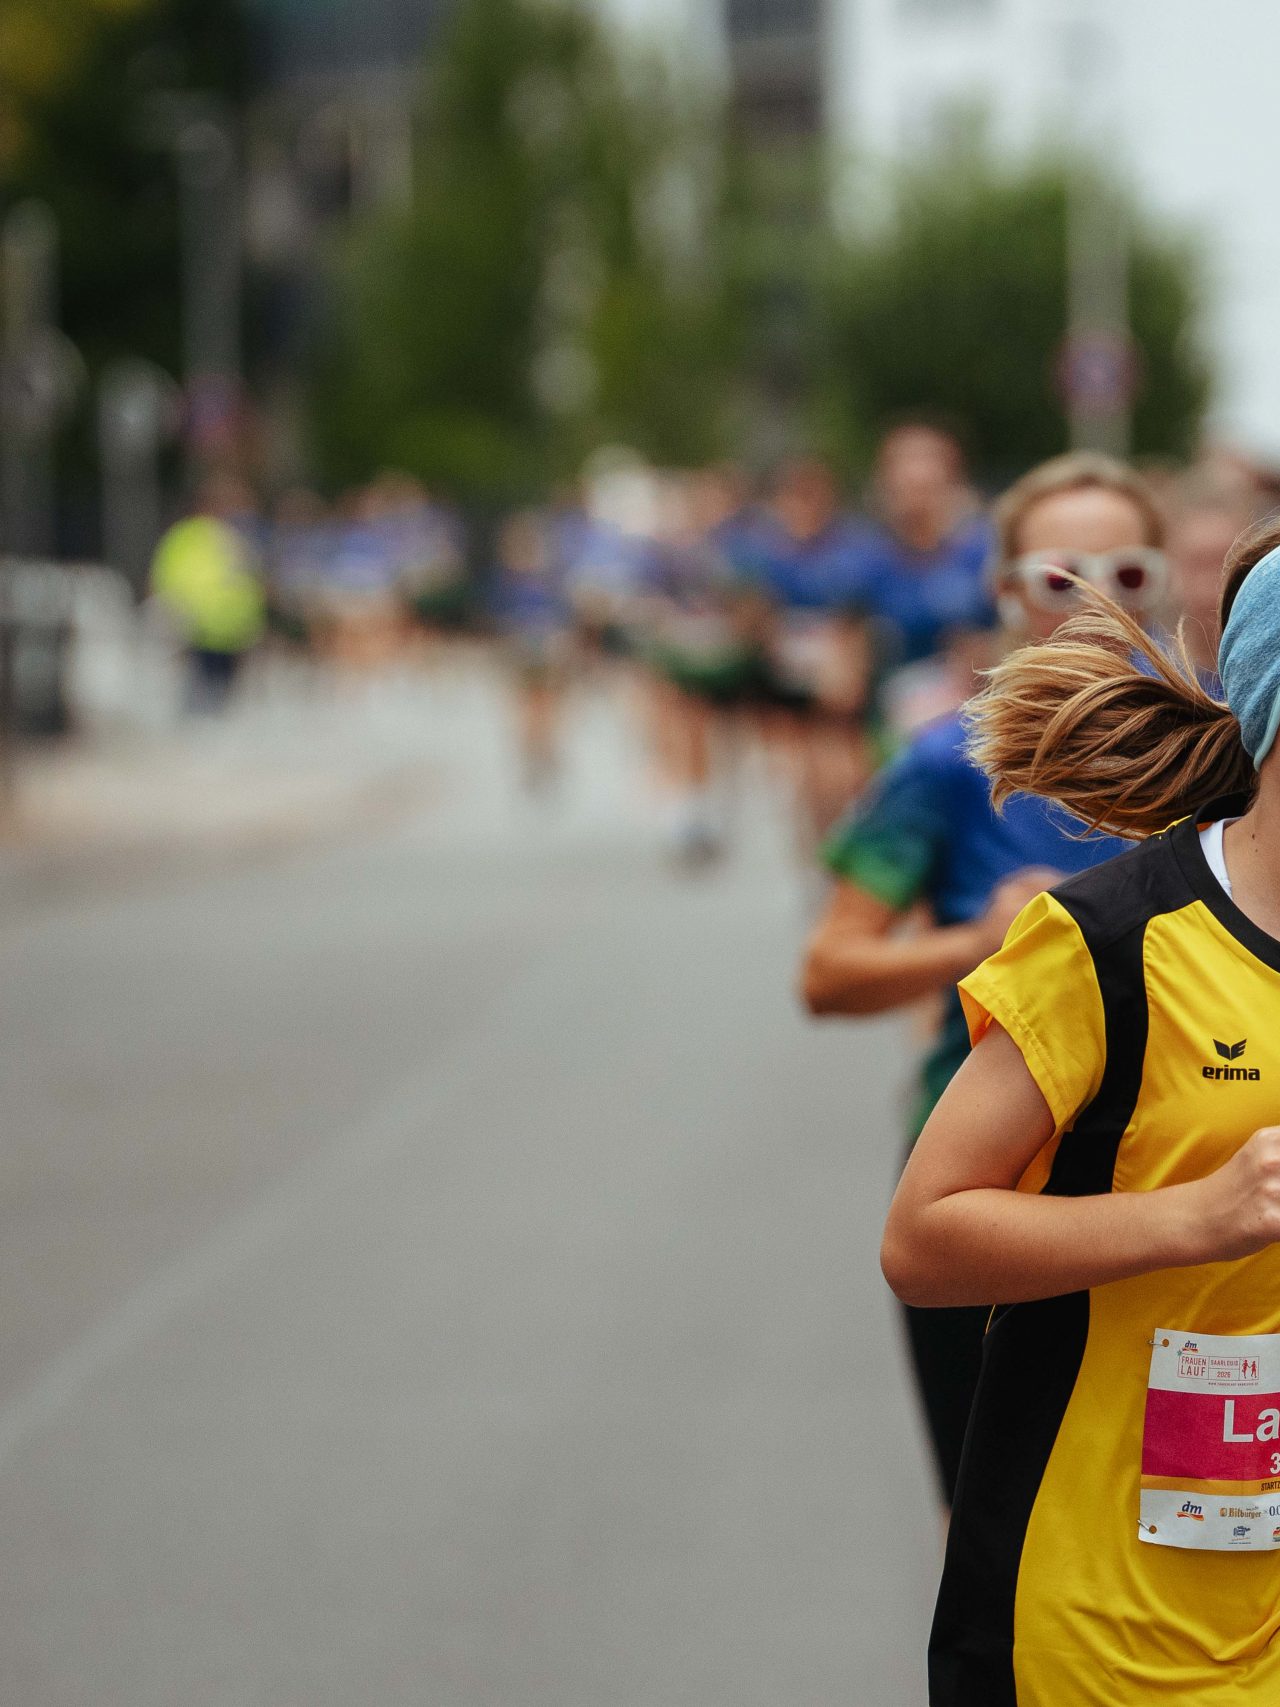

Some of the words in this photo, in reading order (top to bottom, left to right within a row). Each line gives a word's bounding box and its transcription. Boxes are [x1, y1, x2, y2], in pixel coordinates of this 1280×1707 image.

[1202, 1064, 1260, 1081] erima
[1184, 1340, 1197, 1349] dm
[1181, 1356, 1207, 1366] FRAUEN
[1180, 1365, 1206, 1377] LAUF
[1181, 1501, 1202, 1515] dm
[1228, 1507, 1262, 1519] Bitburger
